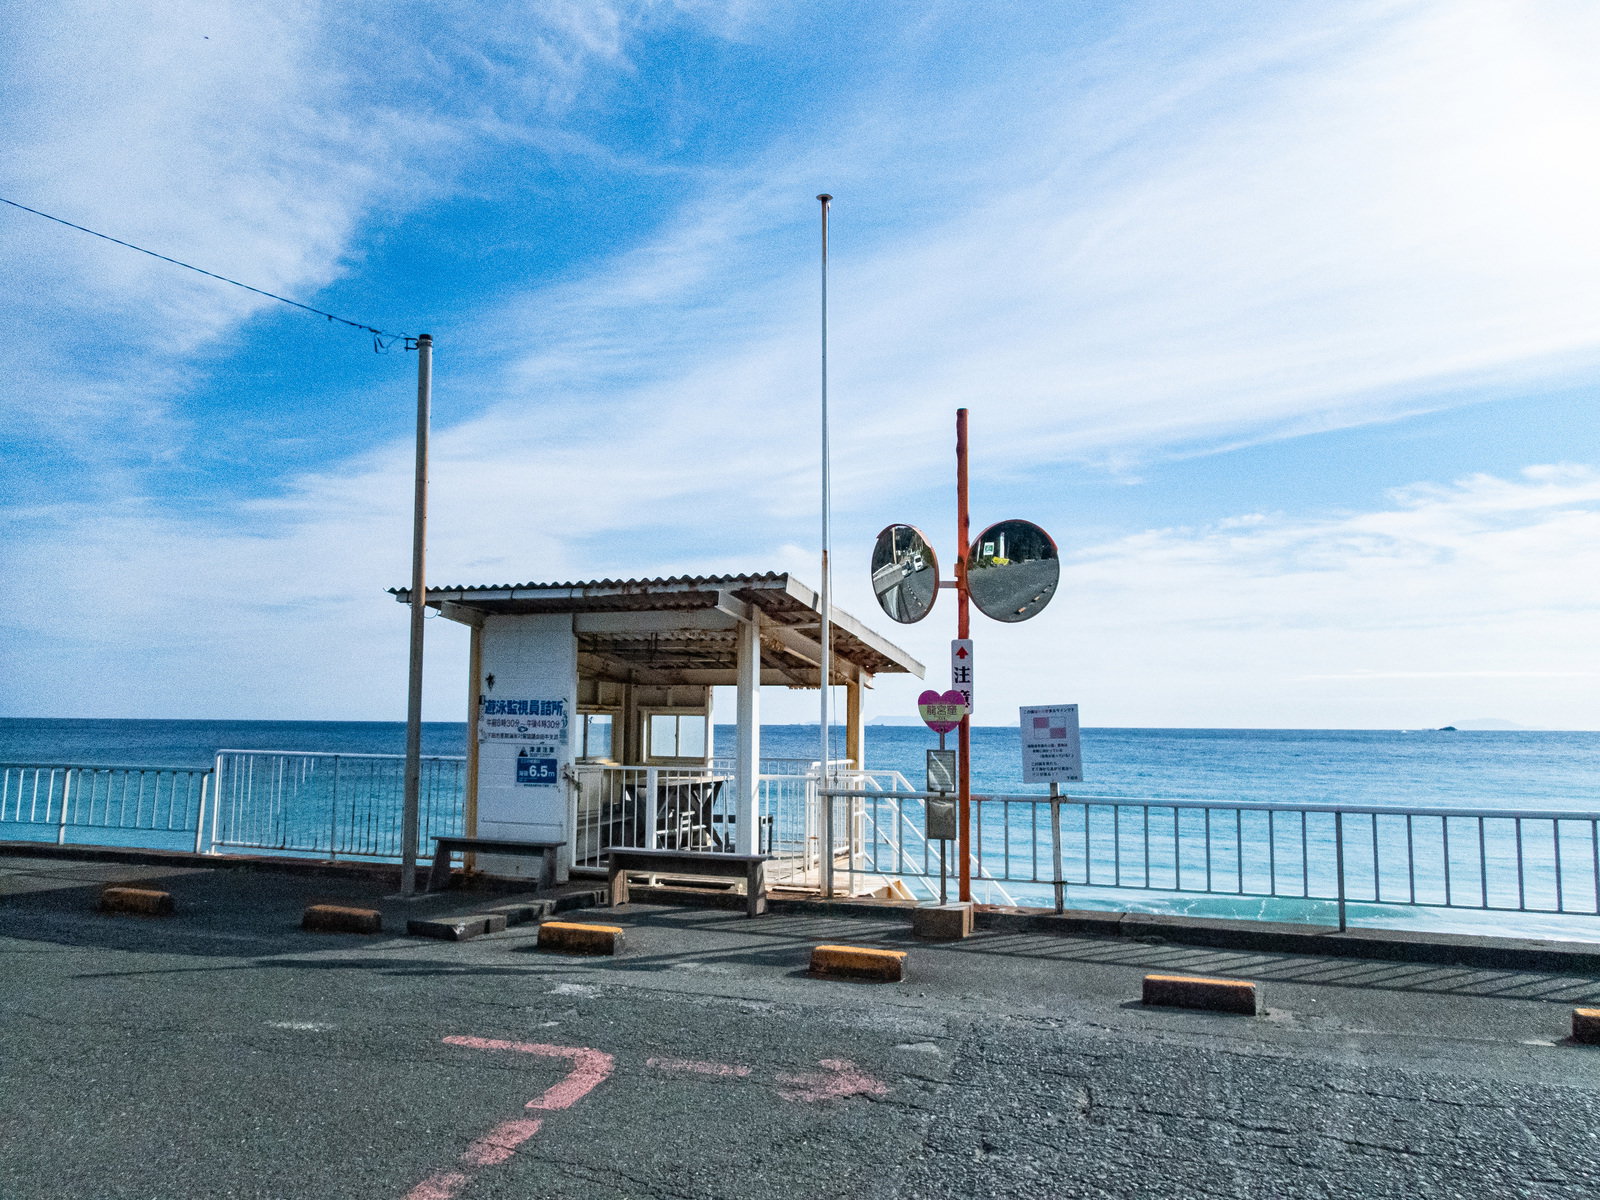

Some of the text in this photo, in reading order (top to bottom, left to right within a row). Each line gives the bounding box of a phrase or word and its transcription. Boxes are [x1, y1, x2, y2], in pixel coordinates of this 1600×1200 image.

[485, 699, 564, 716] 遊泳監視員詰所
